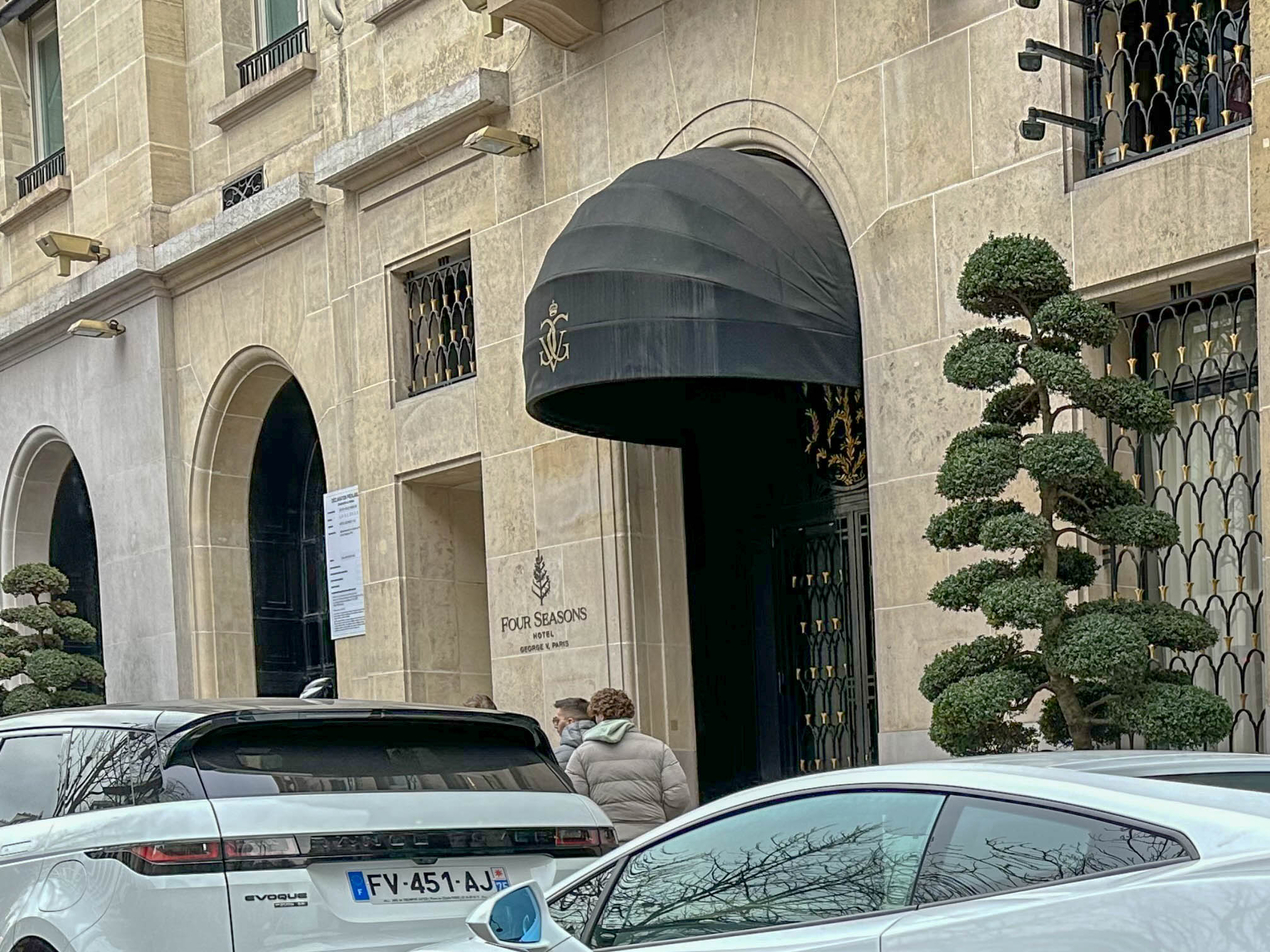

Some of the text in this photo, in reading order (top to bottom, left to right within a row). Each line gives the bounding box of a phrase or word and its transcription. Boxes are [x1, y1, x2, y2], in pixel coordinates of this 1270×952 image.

[501, 606, 588, 633] FOUR SEASONS
[533, 630, 554, 640] HOTEL
[519, 643, 544, 653] GEORGE
[552, 640, 570, 649] PARIS
[244, 892, 308, 902] EVOQUE
